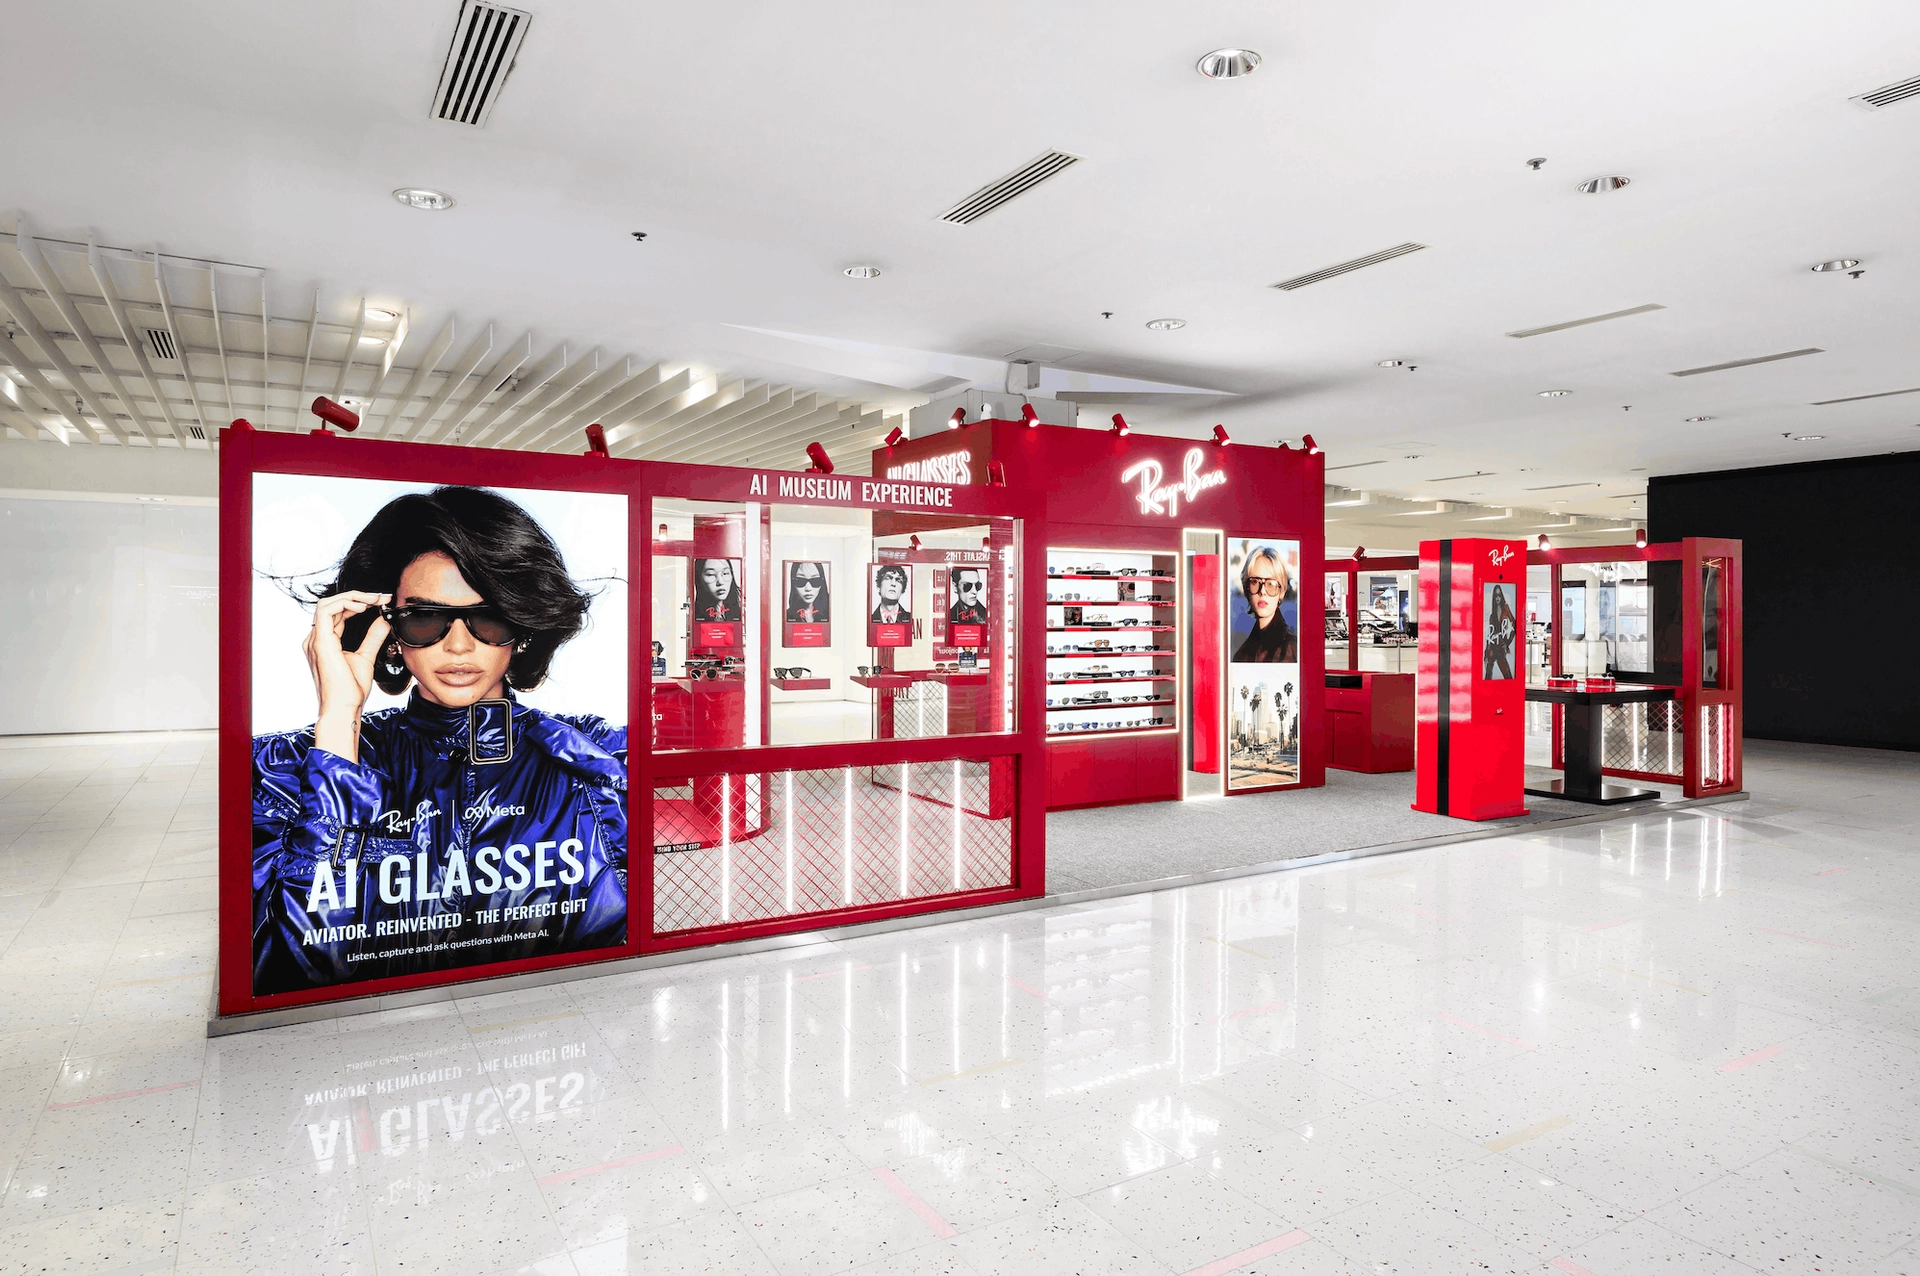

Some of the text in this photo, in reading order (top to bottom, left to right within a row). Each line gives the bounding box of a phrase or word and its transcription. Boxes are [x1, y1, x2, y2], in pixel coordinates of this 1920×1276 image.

[750, 474, 953, 507] AI MUSEUM EXPERIENCE
[1121, 447, 1227, 517] Ray-Ban
[377, 801, 525, 833] Ray-Ban Meta
[306, 838, 585, 913] AI GLASSES
[302, 923, 371, 946] AVIATOR.
[376, 912, 462, 937] REINVENTED
[475, 908, 500, 925] THE
[504, 902, 558, 922] PERFECT
[561, 898, 588, 915] GIFT
[347, 928, 550, 962] Listen, capture and ask questions with Meta AI.
